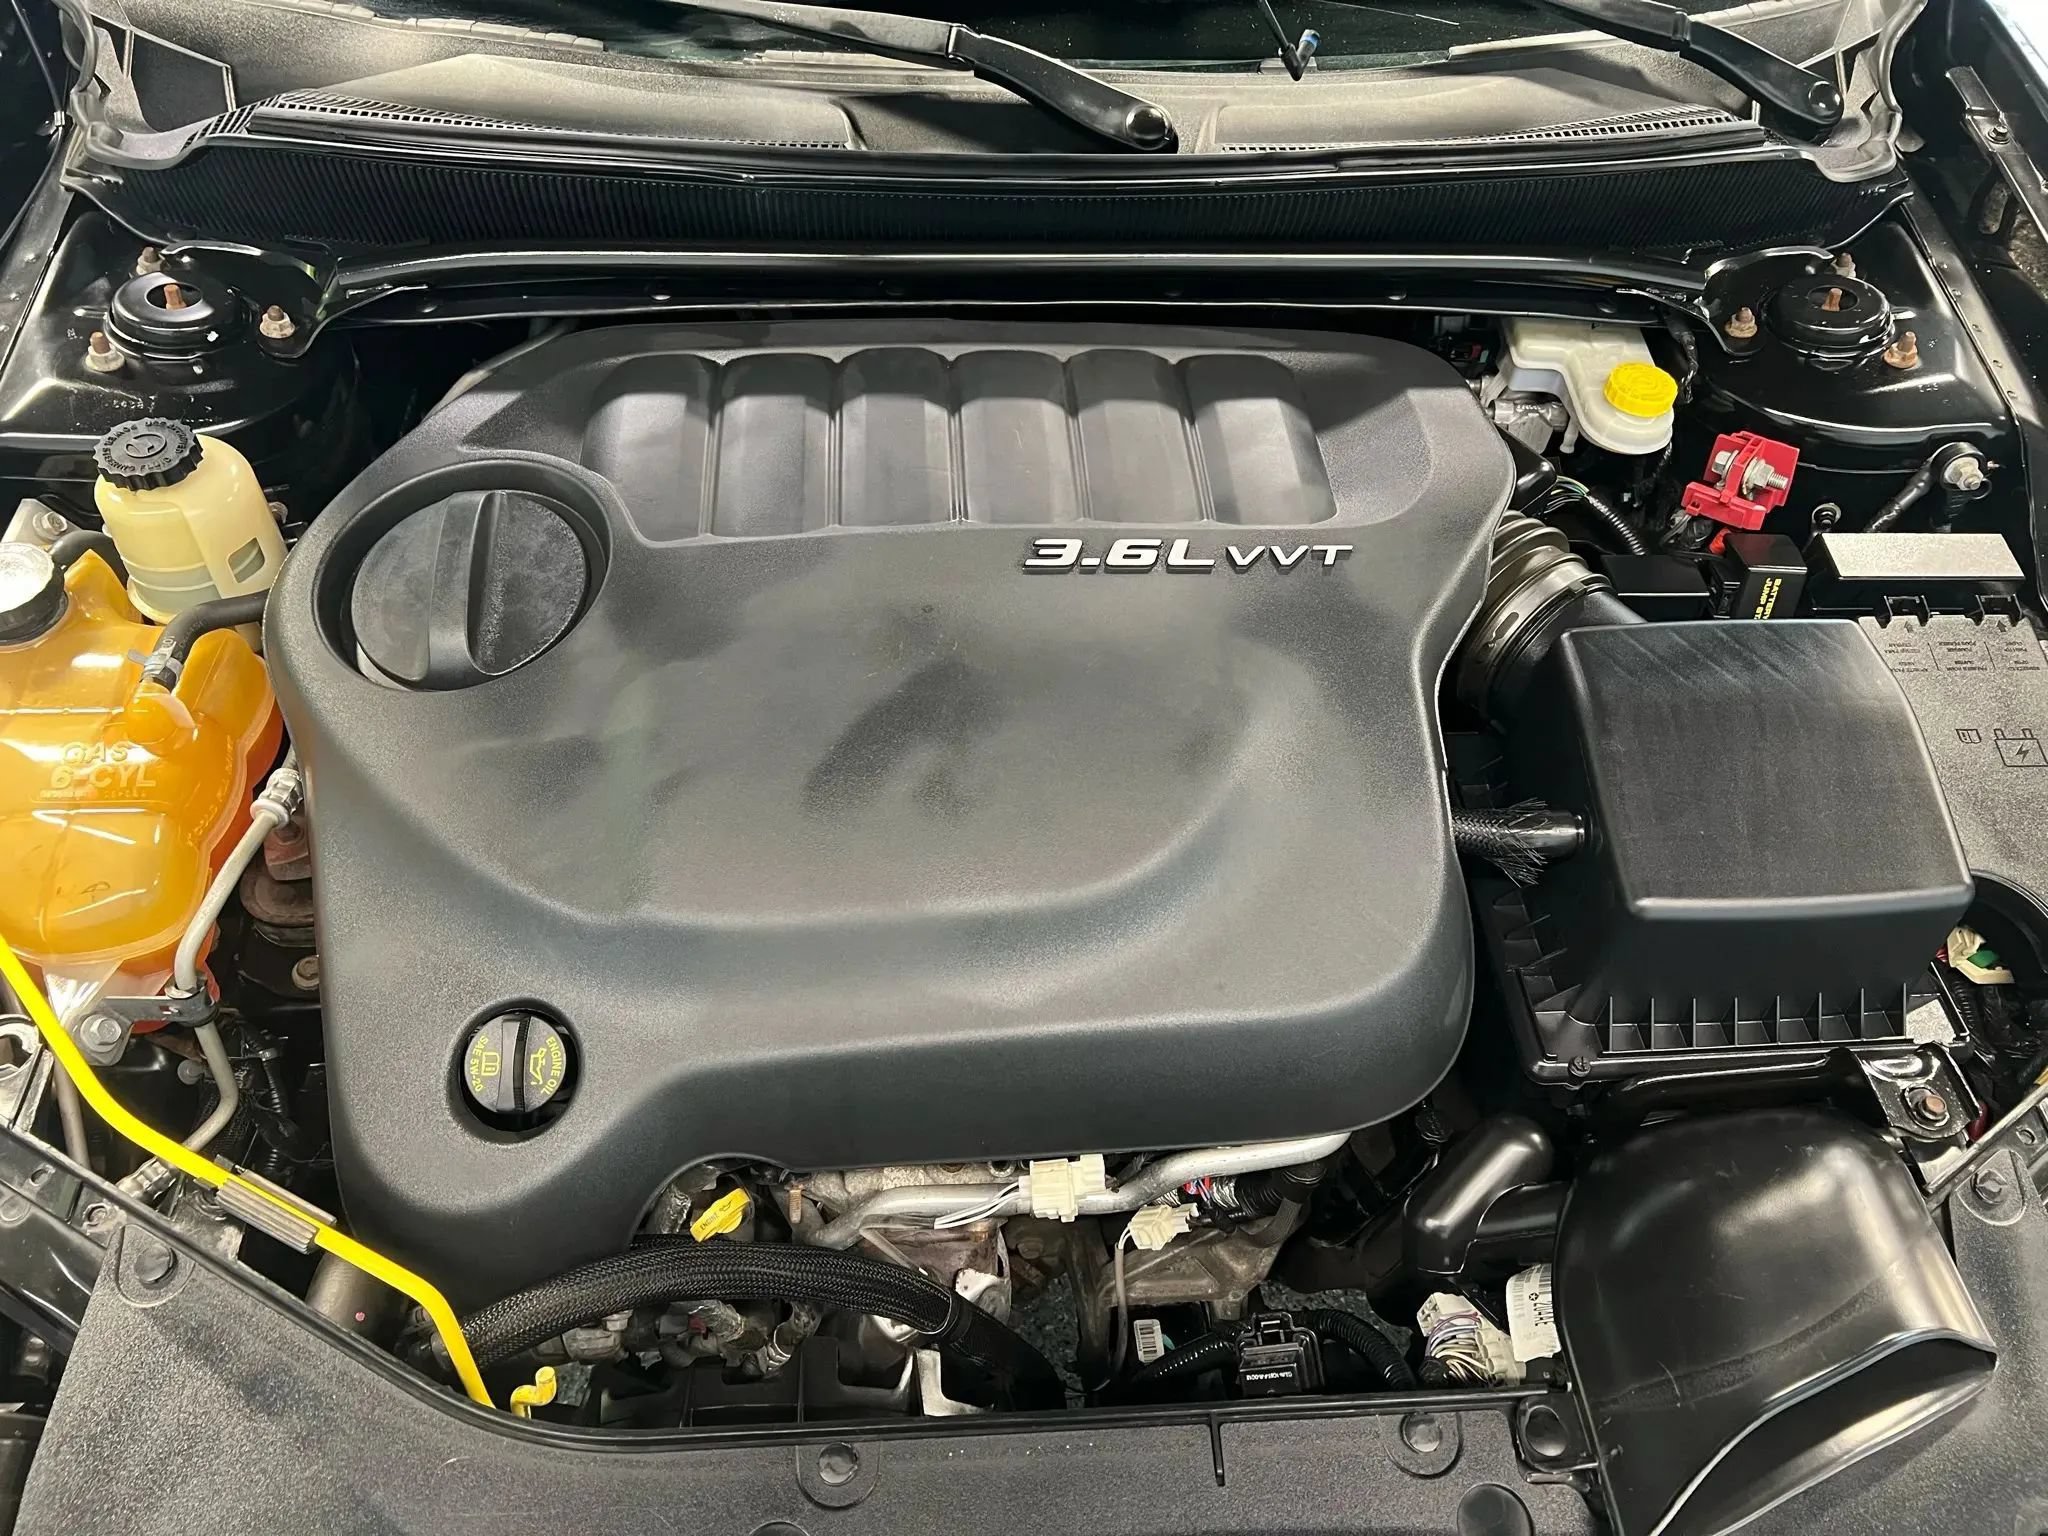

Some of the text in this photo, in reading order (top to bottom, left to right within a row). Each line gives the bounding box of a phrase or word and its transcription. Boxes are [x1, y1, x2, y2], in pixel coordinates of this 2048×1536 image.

[1024, 537, 1354, 573] 3.6L VVT
[1759, 577, 1772, 605] JUMP
[1762, 578, 1782, 620] BATTERY
[63, 740, 129, 764] GAS
[50, 764, 157, 790] 6-CYL
[469, 1035, 489, 1093] SAE 5W-20
[540, 1036, 563, 1095] ENGINE OIL
[699, 1212, 719, 1231] ENGINE
